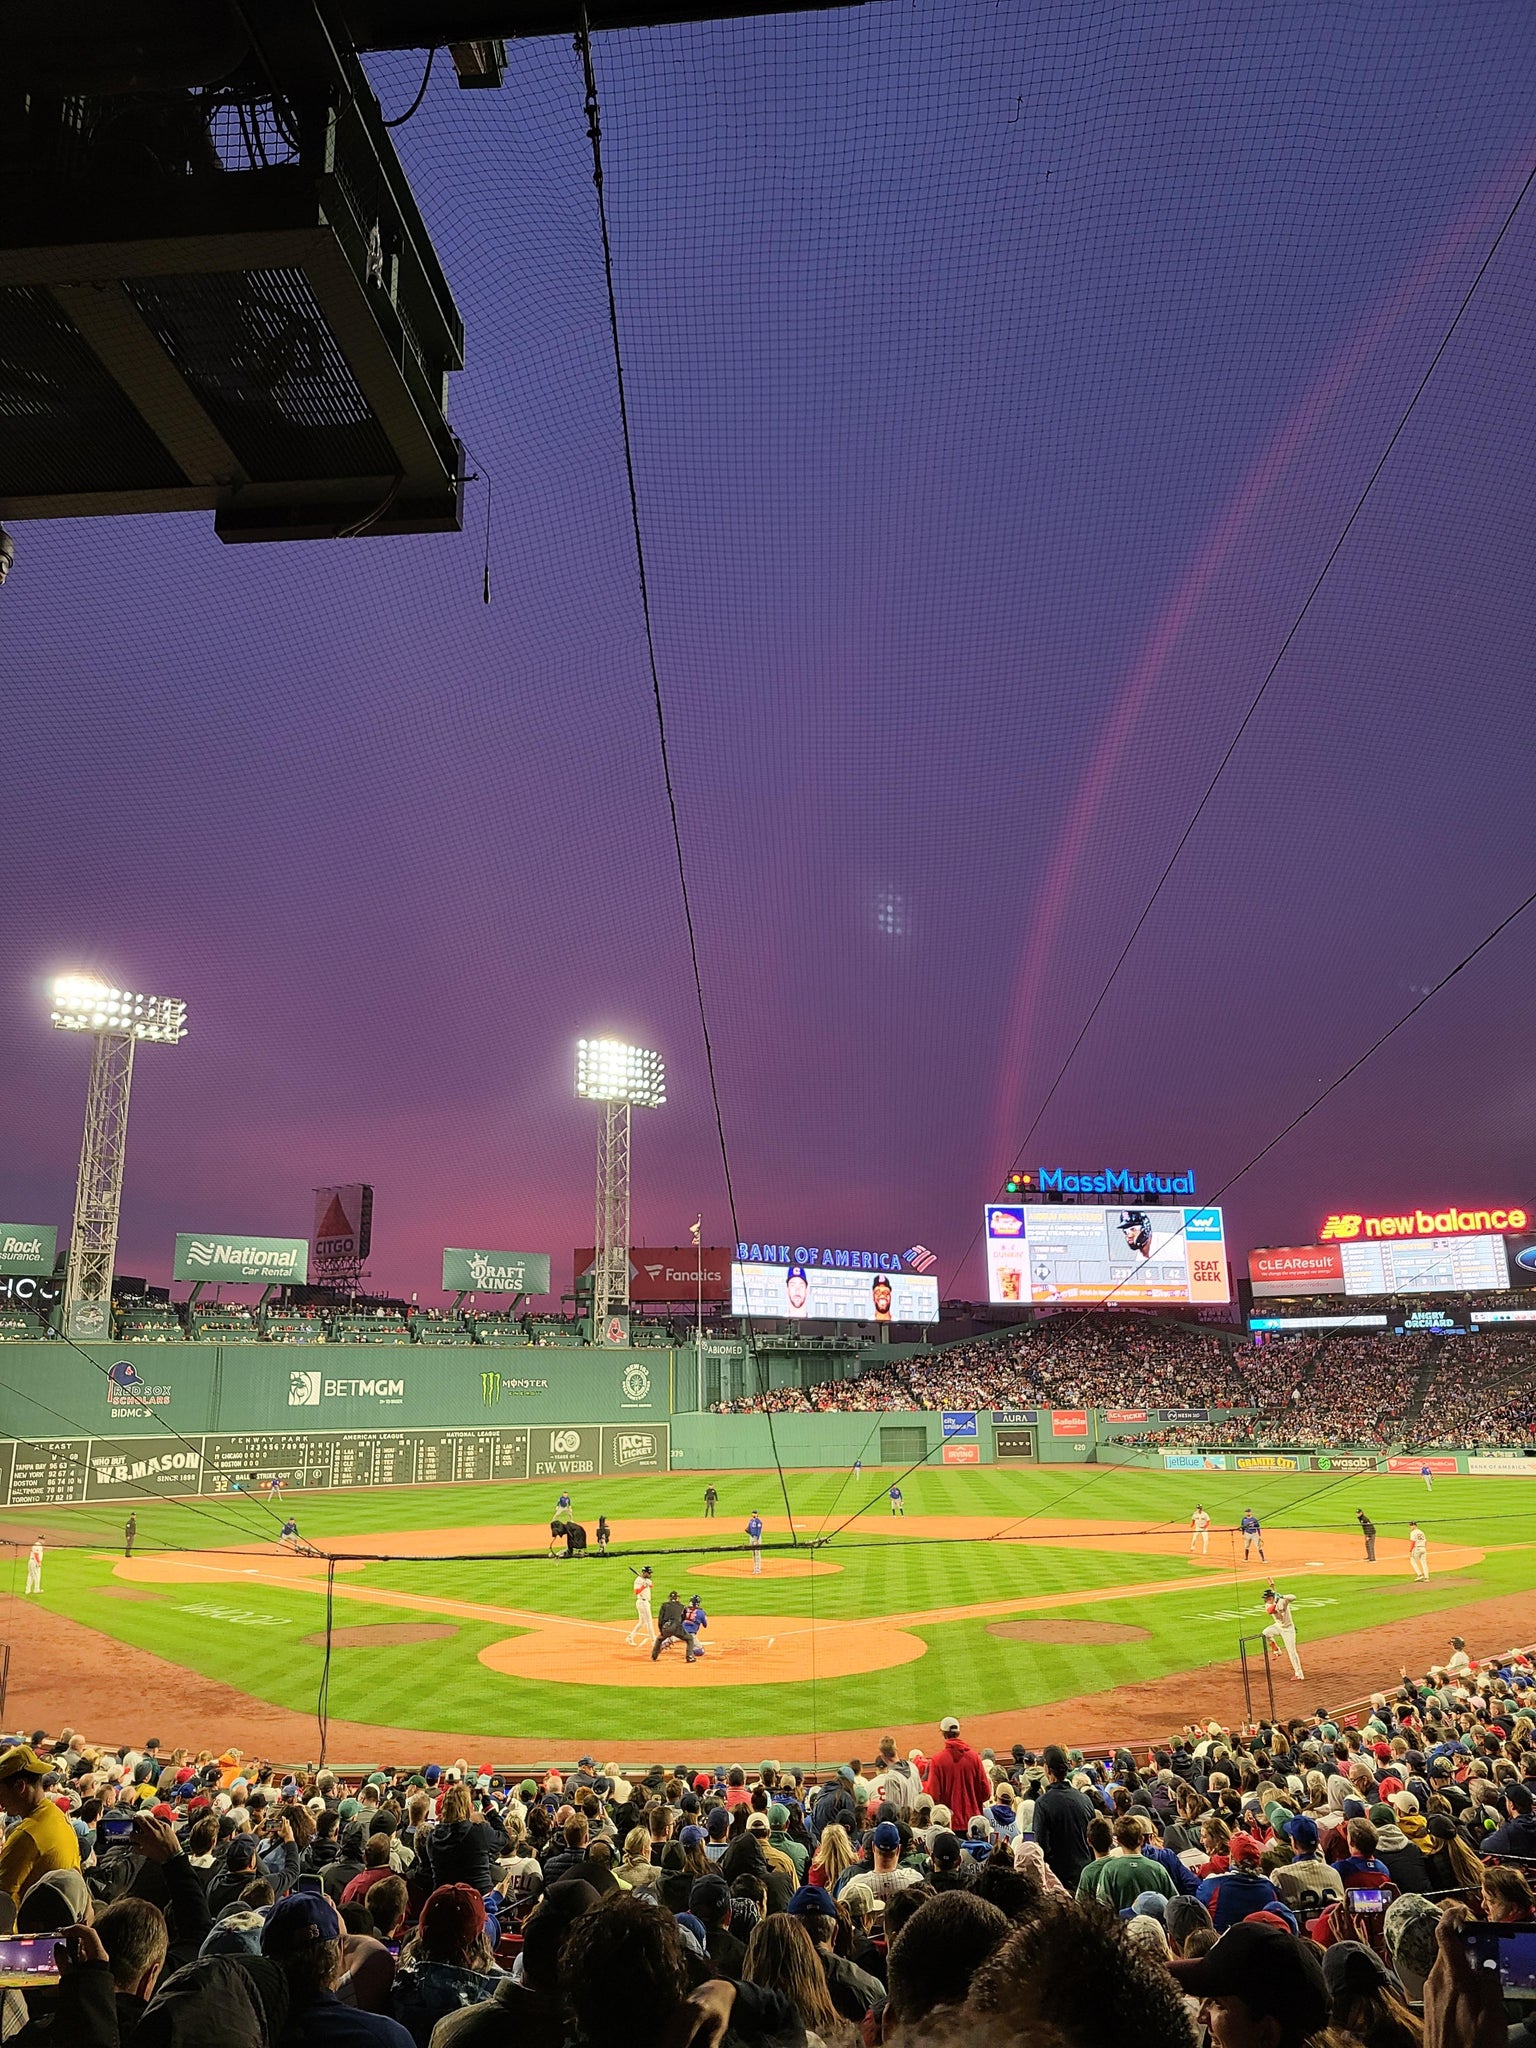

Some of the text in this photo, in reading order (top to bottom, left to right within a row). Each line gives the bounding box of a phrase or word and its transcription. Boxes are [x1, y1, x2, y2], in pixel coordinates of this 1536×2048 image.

[1039, 1167, 1195, 1194] MassMutual
[3, 1237, 42, 1254] Rock
[316, 1239, 354, 1254] CITGO
[213, 1245, 296, 1267] National
[736, 1242, 902, 1270] BANK OF AMERICA
[1194, 1260, 1219, 1271] SEAT
[1258, 1256, 1334, 1270] CLEAResult
[242, 1266, 293, 1277] Car Rental
[471, 1265, 525, 1279] DRAFT
[666, 1268, 721, 1281] Fanatics
[1145, 1269, 1180, 1278] 6 42
[1193, 1272, 1221, 1282] GEEK
[476, 1277, 523, 1290] KINGS
[1411, 1311, 1446, 1320] ANGRY
[1404, 1319, 1454, 1328] ORCHARD
[707, 1346, 743, 1355] ABIOMED
[324, 1380, 404, 1396] BETMGM
[502, 1379, 548, 1388] MONSTER
[114, 1386, 172, 1396] RED SOX
[113, 1396, 170, 1405] SCHOLARS
[111, 1408, 143, 1418] BIDMC
[1122, 1412, 1147, 1421] TICKET
[1053, 1418, 1086, 1426] Safelite
[231, 1436, 274, 1444] FENWAY
[549, 1430, 581, 1453] 160
[621, 1435, 653, 1450] ACE
[221, 1452, 243, 1460] CHICAGO
[622, 1447, 653, 1459] TICKET
[670, 1449, 684, 1458] 379
[92, 1456, 126, 1466] WHO BUT
[220, 1460, 242, 1468] BOSTON
[1168, 1456, 1200, 1468] jetBlue
[1237, 1456, 1297, 1469] GRANITE CITY
[1331, 1457, 1370, 1468] wasabi
[15, 1463, 34, 1471] TAMPA
[559, 1460, 594, 1473] WEBB
[48, 1470, 57, 1478] 92
[13, 1479, 38, 1487] BOSTON
[214, 1481, 228, 1492] 32
[12, 1487, 45, 1495] BALTIMORE
[45, 1494, 55, 1502] 77
